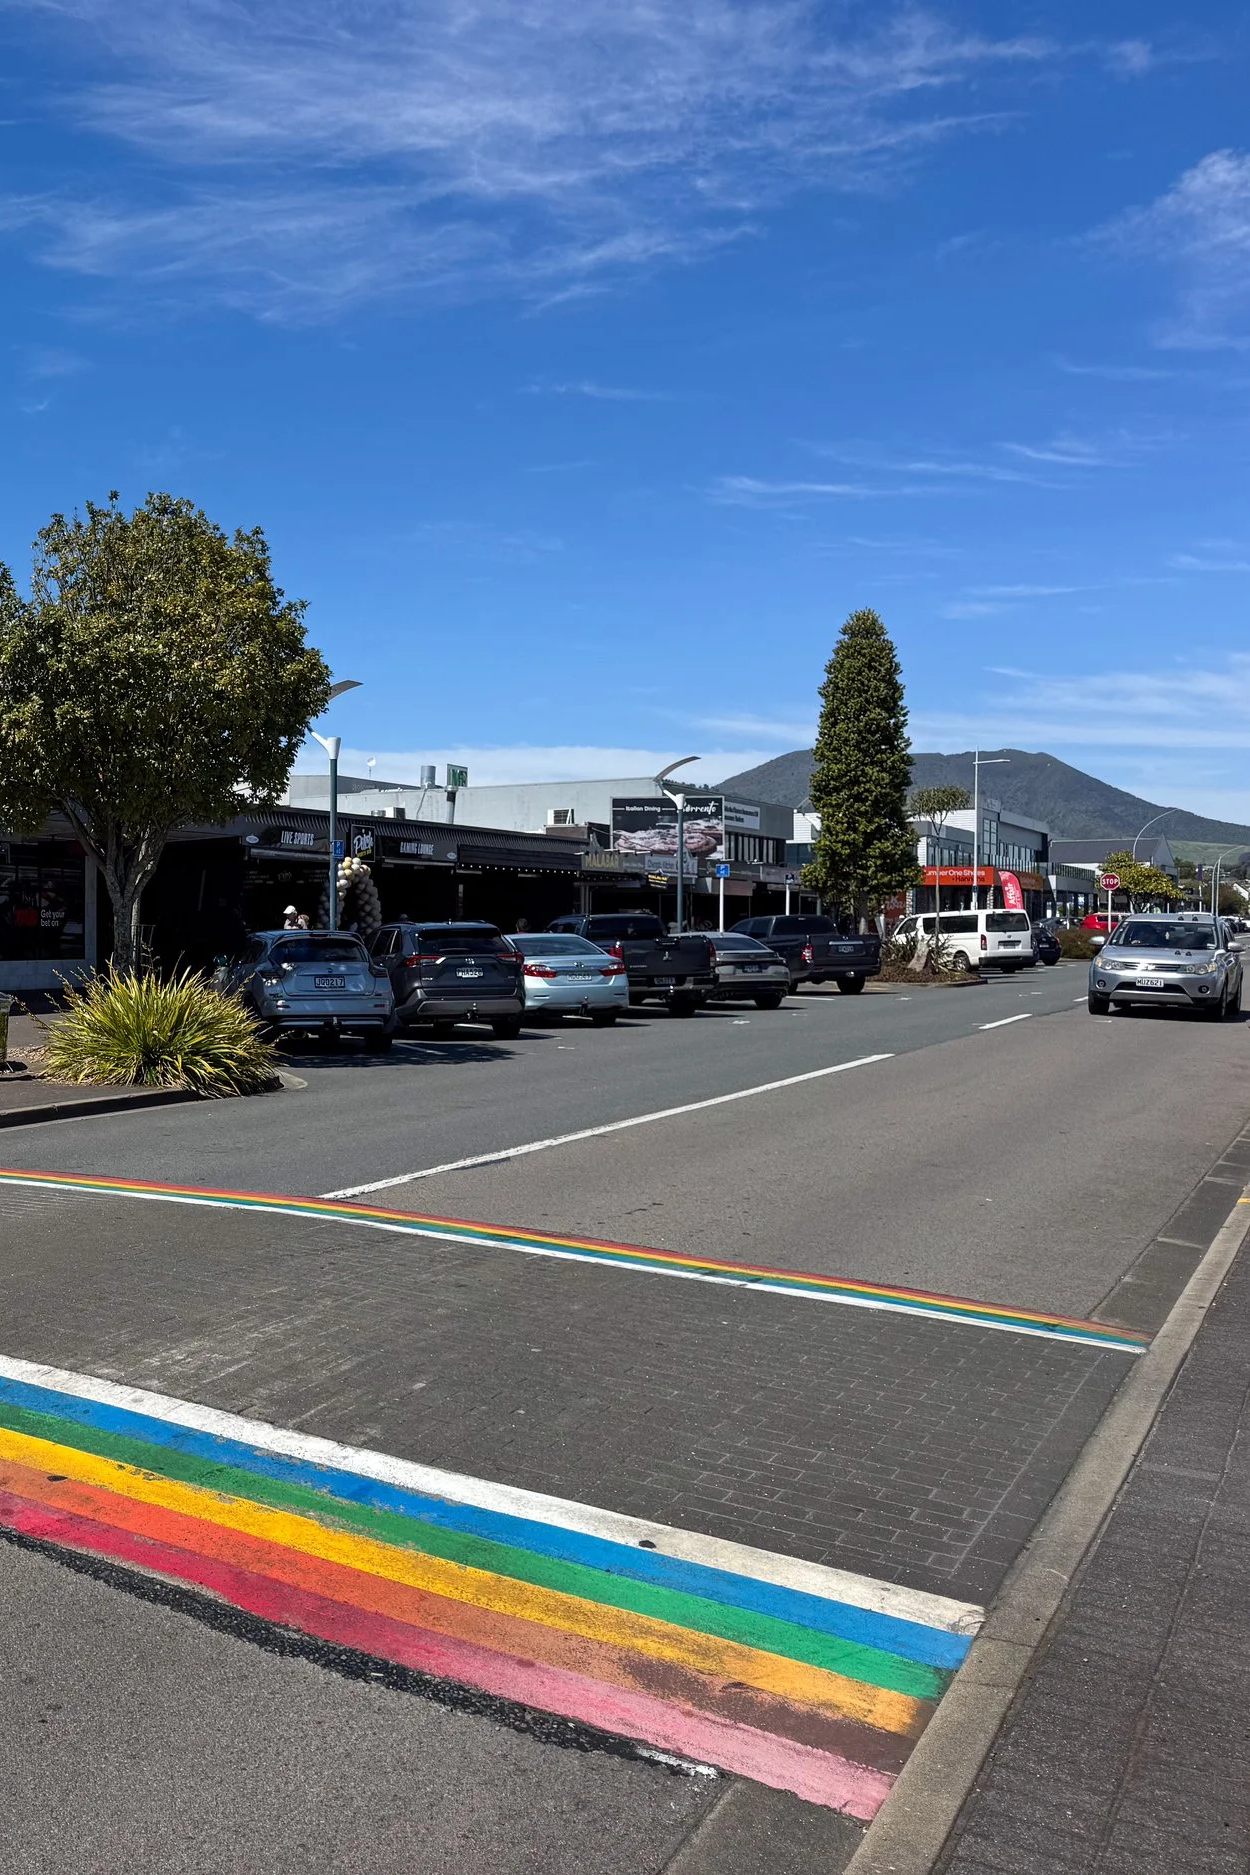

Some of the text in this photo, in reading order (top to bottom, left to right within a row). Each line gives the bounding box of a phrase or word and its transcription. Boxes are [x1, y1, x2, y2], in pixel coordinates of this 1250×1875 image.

[280, 830, 315, 847] LIVE SPORTS
[585, 853, 619, 868] MALABAR
